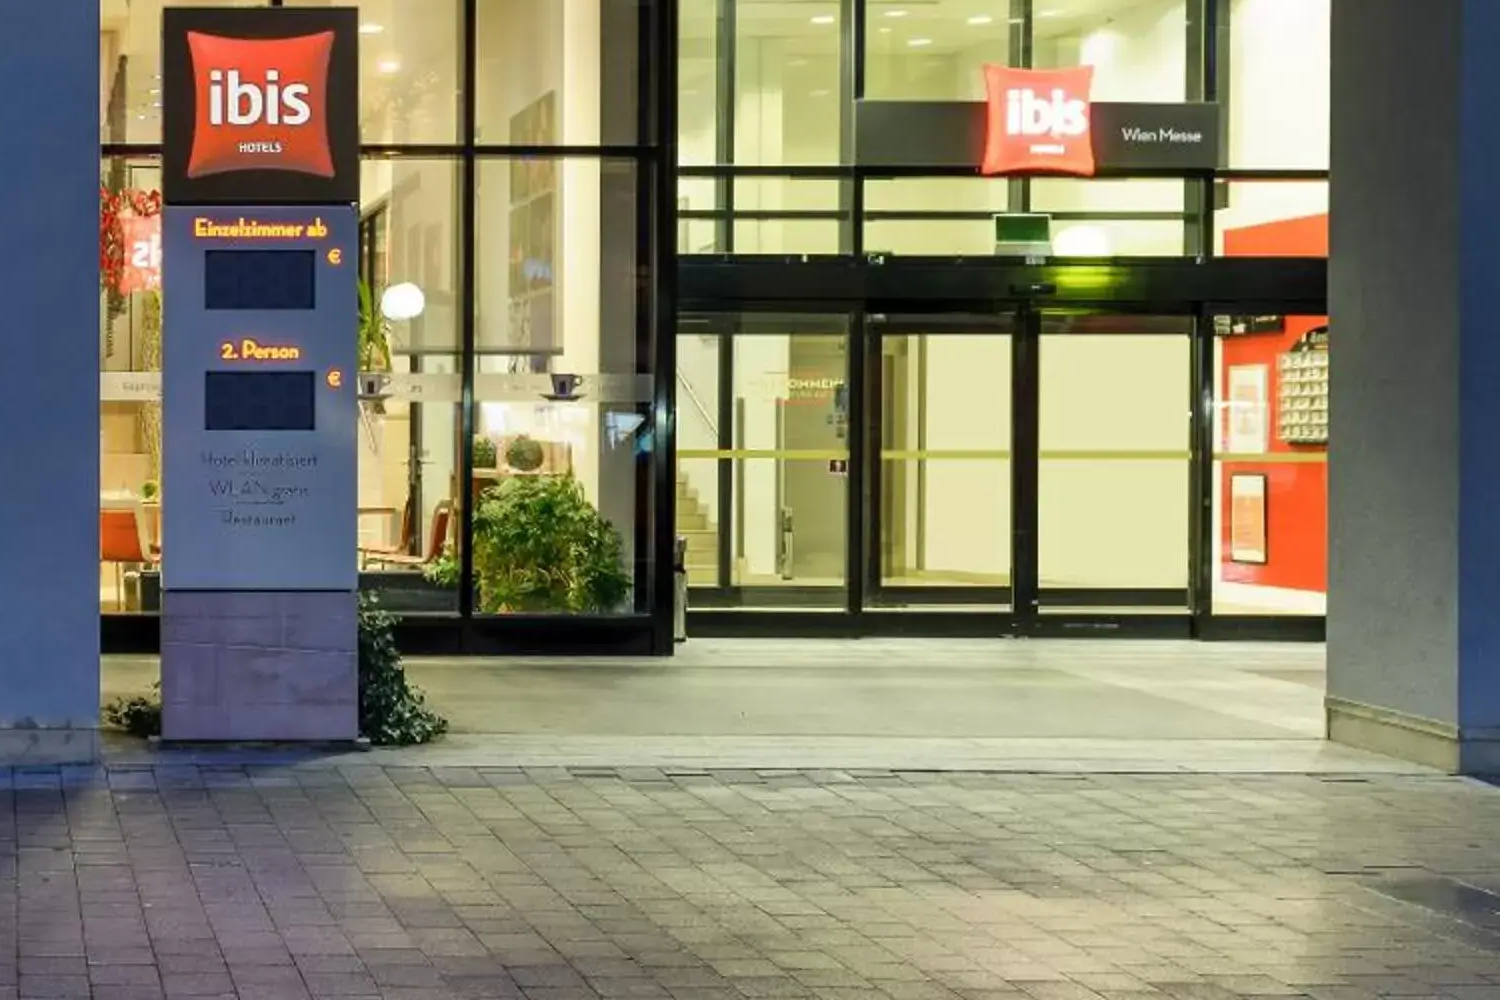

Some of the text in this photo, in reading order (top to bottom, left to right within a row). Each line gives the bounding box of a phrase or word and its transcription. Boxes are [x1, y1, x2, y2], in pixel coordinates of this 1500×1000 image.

[209, 68, 311, 125] ibis
[1006, 87, 1088, 135] ibis
[1121, 127, 1202, 142] Wien Messe
[239, 142, 282, 154] HOTELS
[195, 217, 328, 238] Einzelzimmer ab
[327, 248, 342, 265] €
[221, 339, 299, 359] 2. Person
[327, 370, 342, 387] €
